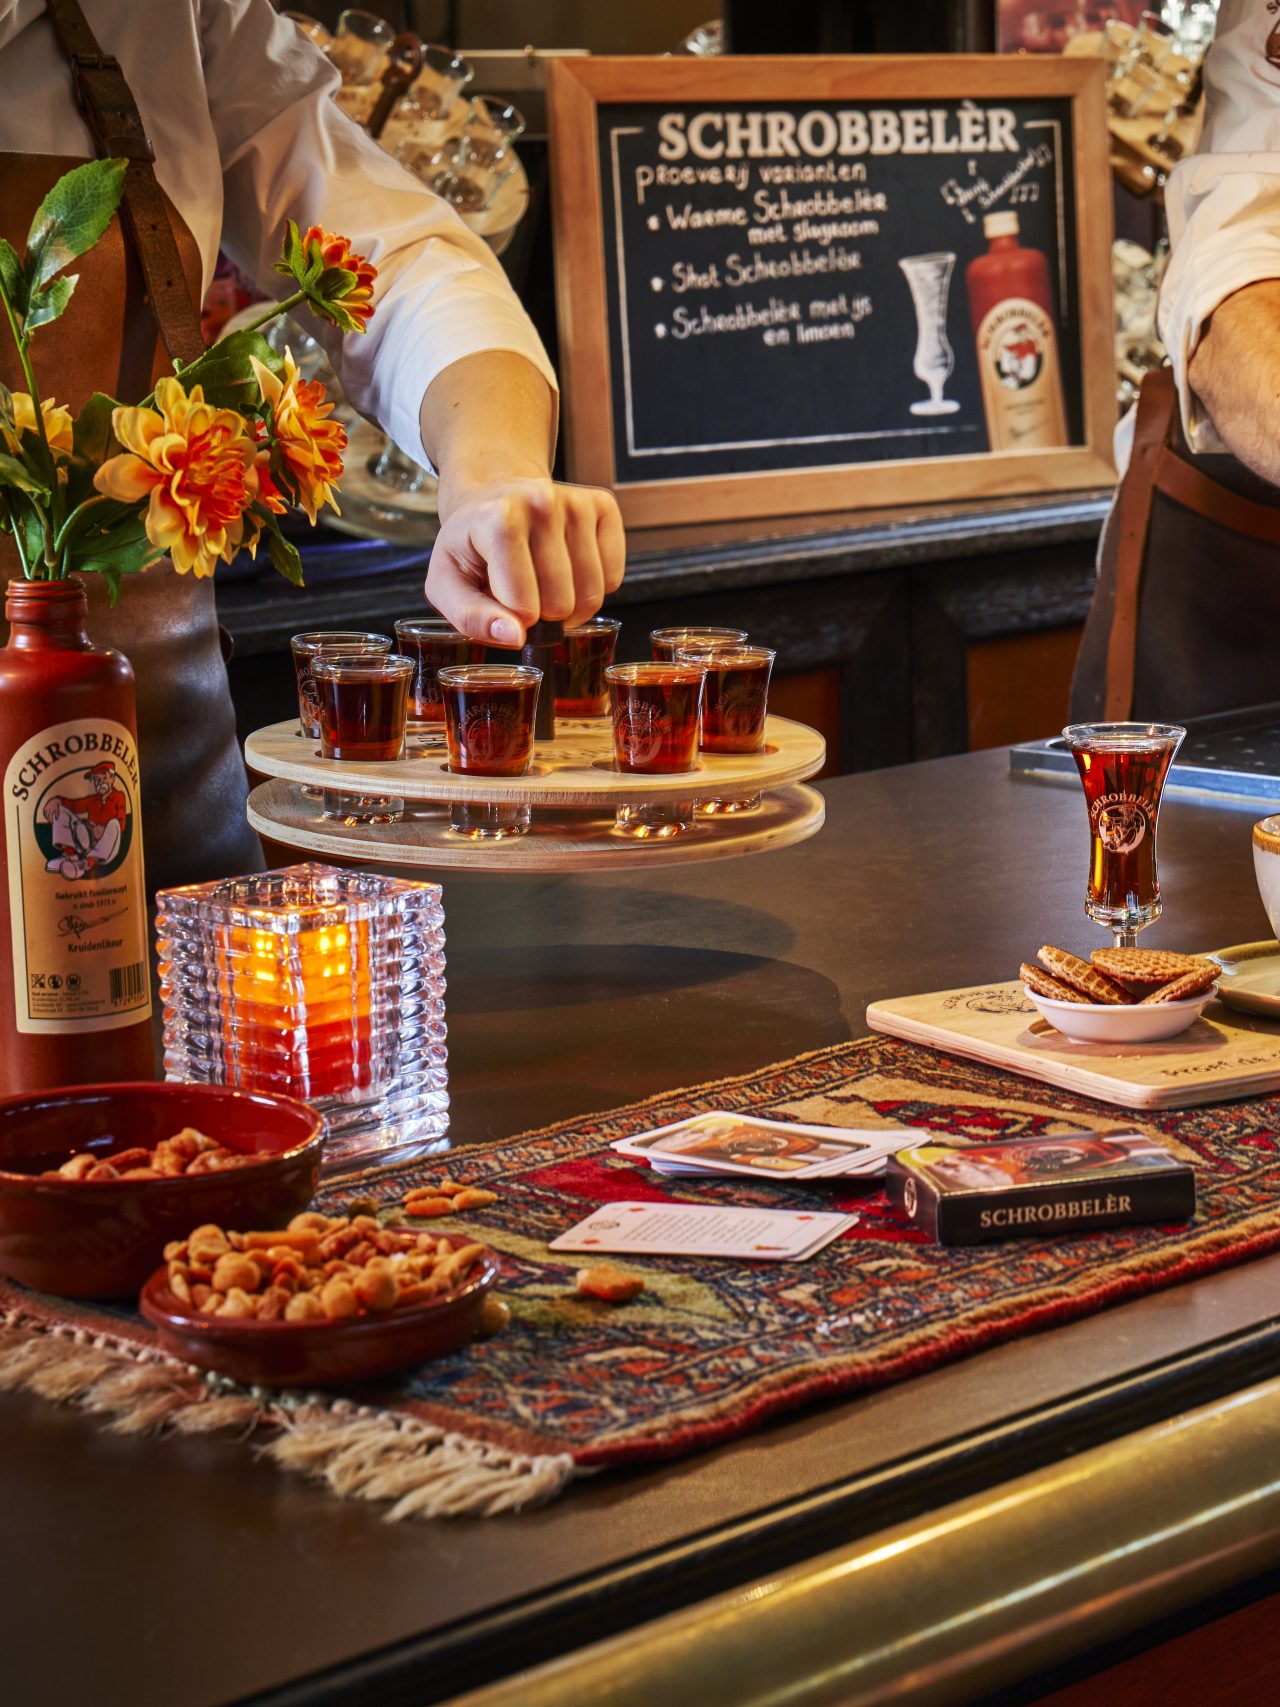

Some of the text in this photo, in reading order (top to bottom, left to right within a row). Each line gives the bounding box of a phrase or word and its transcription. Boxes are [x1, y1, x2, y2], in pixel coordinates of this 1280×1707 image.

[658, 98, 1020, 160] SCHROBBELÈR
[759, 160, 867, 184] varianten
[666, 203, 748, 230] Warme
[748, 223, 788, 245] met
[671, 261, 721, 293] Shot
[809, 293, 849, 319] met
[763, 327, 790, 346] en
[68, 939, 123, 953] Kruidenlikeur
[980, 1193, 1132, 1228] SCHROBBELÈR
